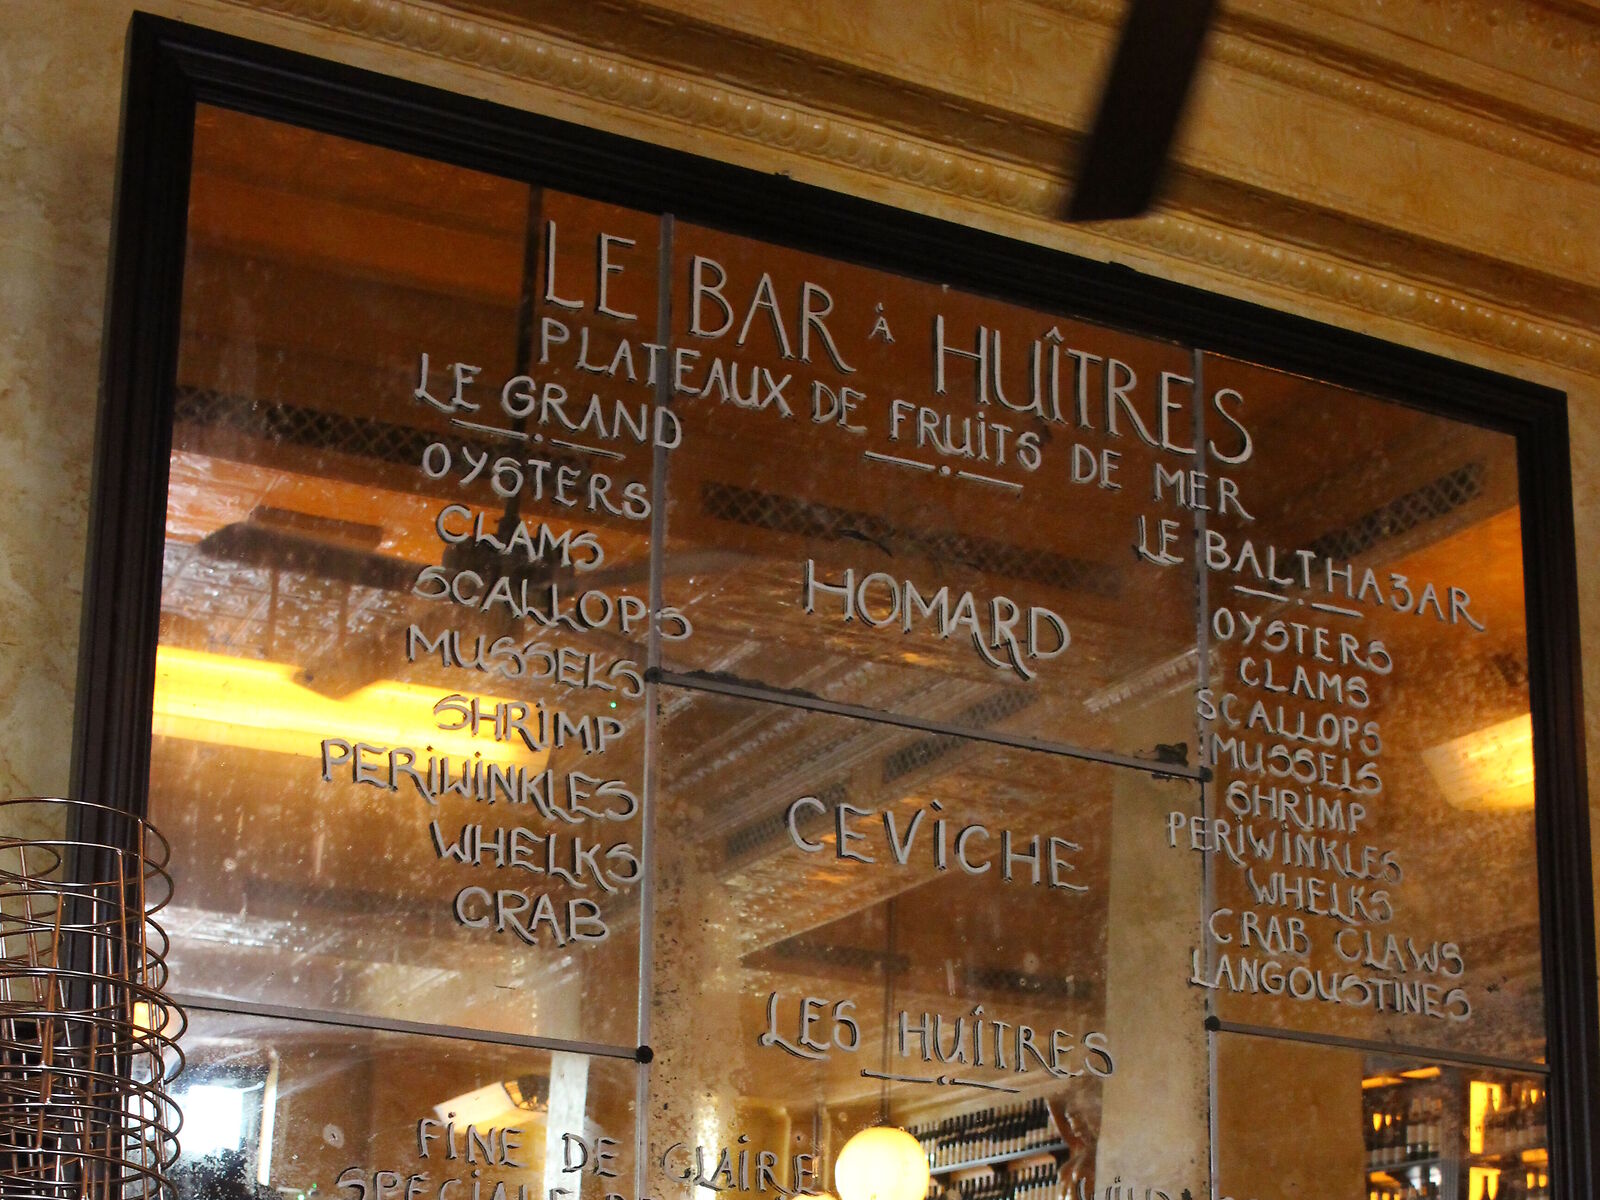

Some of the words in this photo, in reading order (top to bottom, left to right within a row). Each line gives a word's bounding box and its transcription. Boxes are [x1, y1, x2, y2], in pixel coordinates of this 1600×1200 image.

[545, 219, 638, 320] LE
[688, 254, 858, 374] BAR
[934, 314, 1254, 466] HUÎTRES
[414, 353, 483, 412] LE
[501, 374, 684, 450] GRAND
[539, 316, 794, 418] PLATEAUX
[811, 379, 868, 433] DE
[889, 399, 1043, 472] FRUITS
[1071, 442, 1123, 490] DE
[1153, 462, 1256, 521] MER
[421, 441, 652, 520] OYSTERS
[435, 504, 605, 572] CLAMS
[1134, 513, 1185, 567] LE
[410, 563, 694, 642] SCALLOPS
[803, 558, 1072, 682] HOMARD
[406, 622, 646, 699] MUSSELS
[1212, 606, 1394, 676] OYSTERS
[1239, 656, 1372, 710] CLAMS
[432, 693, 626, 756] SHRIMP
[1195, 685, 1383, 758] SCALLOPS
[320, 737, 640, 825] PERIWINKLES
[1209, 731, 1384, 797] MUSSELS
[785, 796, 1090, 893] CEVICHE
[1225, 779, 1367, 834] SHRIMP
[429, 819, 644, 895] WHELKS
[1167, 810, 1403, 884] PERIWINKLES
[453, 885, 611, 949] CRAB
[1246, 867, 1395, 927] WHELKS
[1208, 907, 1311, 958] CRAB
[1335, 926, 1466, 979] CLAWS
[1186, 946, 1473, 1023] LANGOUSTINES
[757, 990, 862, 1062] LES
[899, 1004, 1118, 1080] HUÎTRES
[416, 1111, 529, 1169] FINE
[561, 1132, 622, 1178] DE
[661, 1133, 824, 1198] CLAIRE
